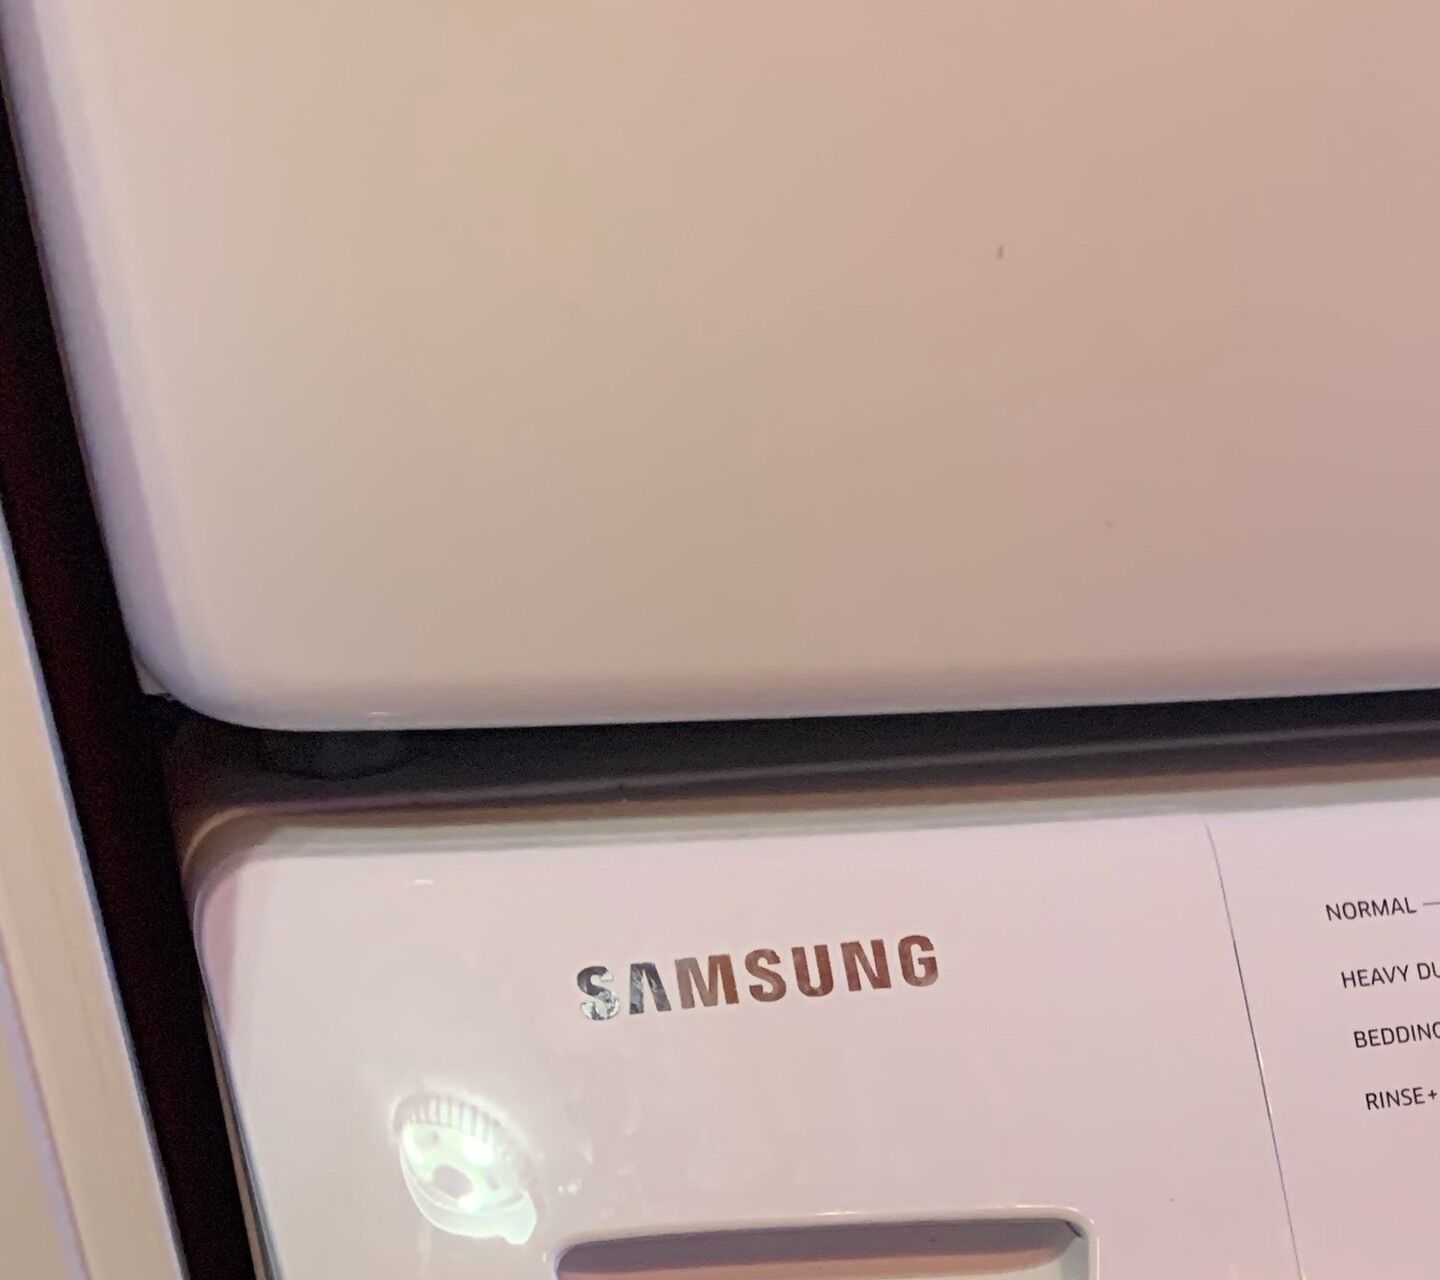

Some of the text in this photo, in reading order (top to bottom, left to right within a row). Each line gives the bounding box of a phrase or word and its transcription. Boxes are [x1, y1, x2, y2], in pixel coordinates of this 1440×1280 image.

[1326, 895, 1417, 922] NORMAL
[576, 934, 939, 1021] SAMSUNG
[1341, 963, 1410, 990] HEAVY
